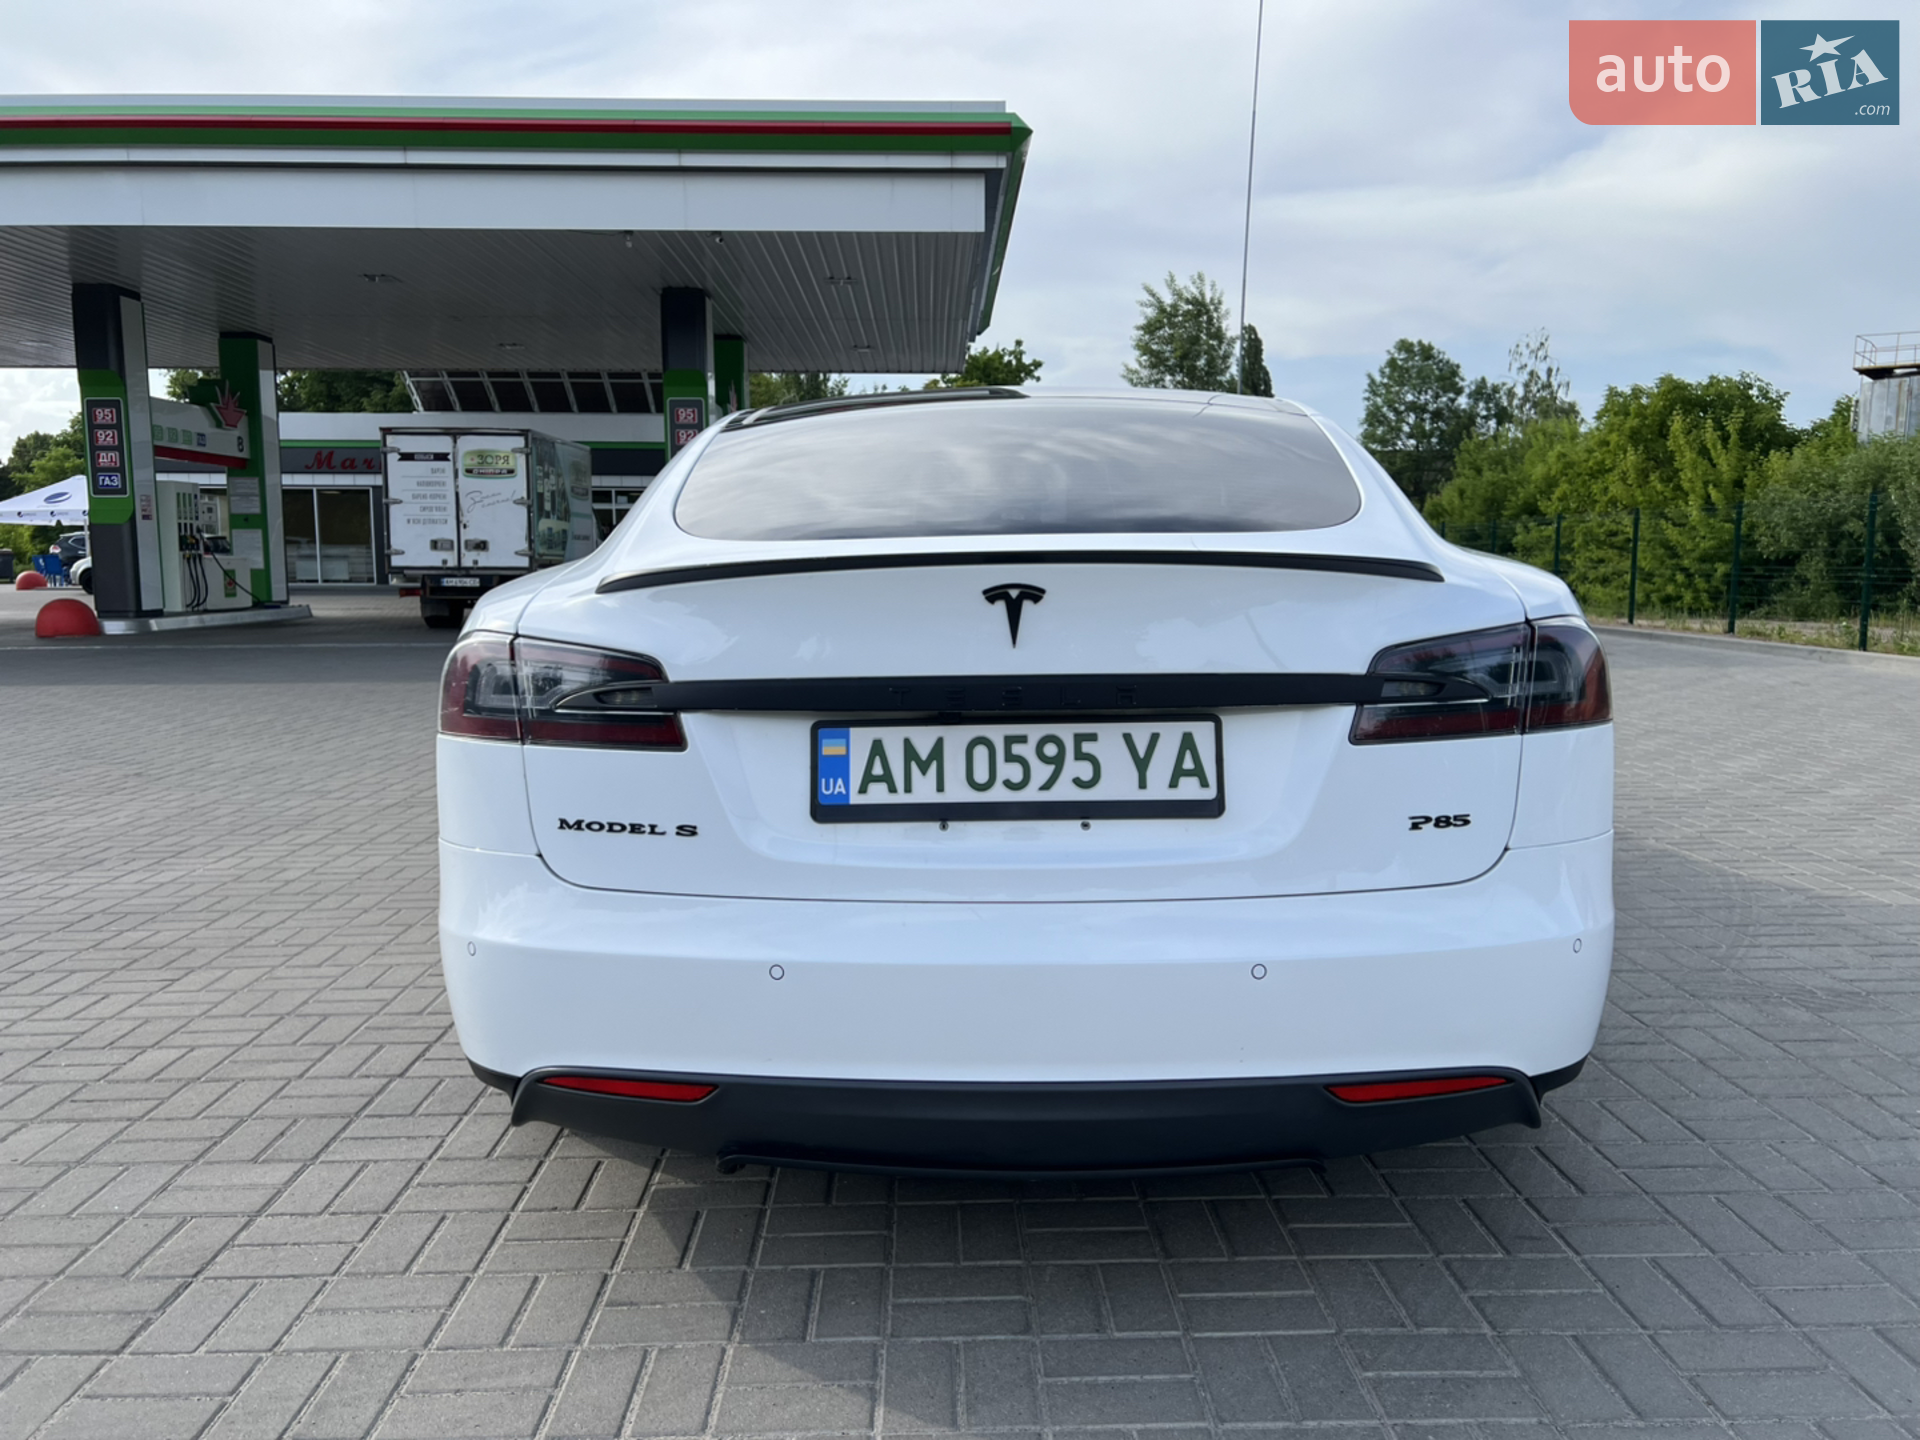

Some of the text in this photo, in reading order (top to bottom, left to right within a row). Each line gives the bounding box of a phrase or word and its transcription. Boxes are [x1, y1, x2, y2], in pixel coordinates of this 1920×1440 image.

[95, 408, 112, 420] 95
[678, 408, 694, 420] 95
[97, 430, 113, 441] 92
[98, 452, 116, 463] ДП
[477, 454, 510, 465] ЗОРЯ
[99, 475, 119, 487] ГАЗ
[857, 731, 1210, 794] AM 0595 YA
[820, 777, 847, 795] UA
[557, 817, 699, 837] MODEL S
[1408, 813, 1472, 831] P85
